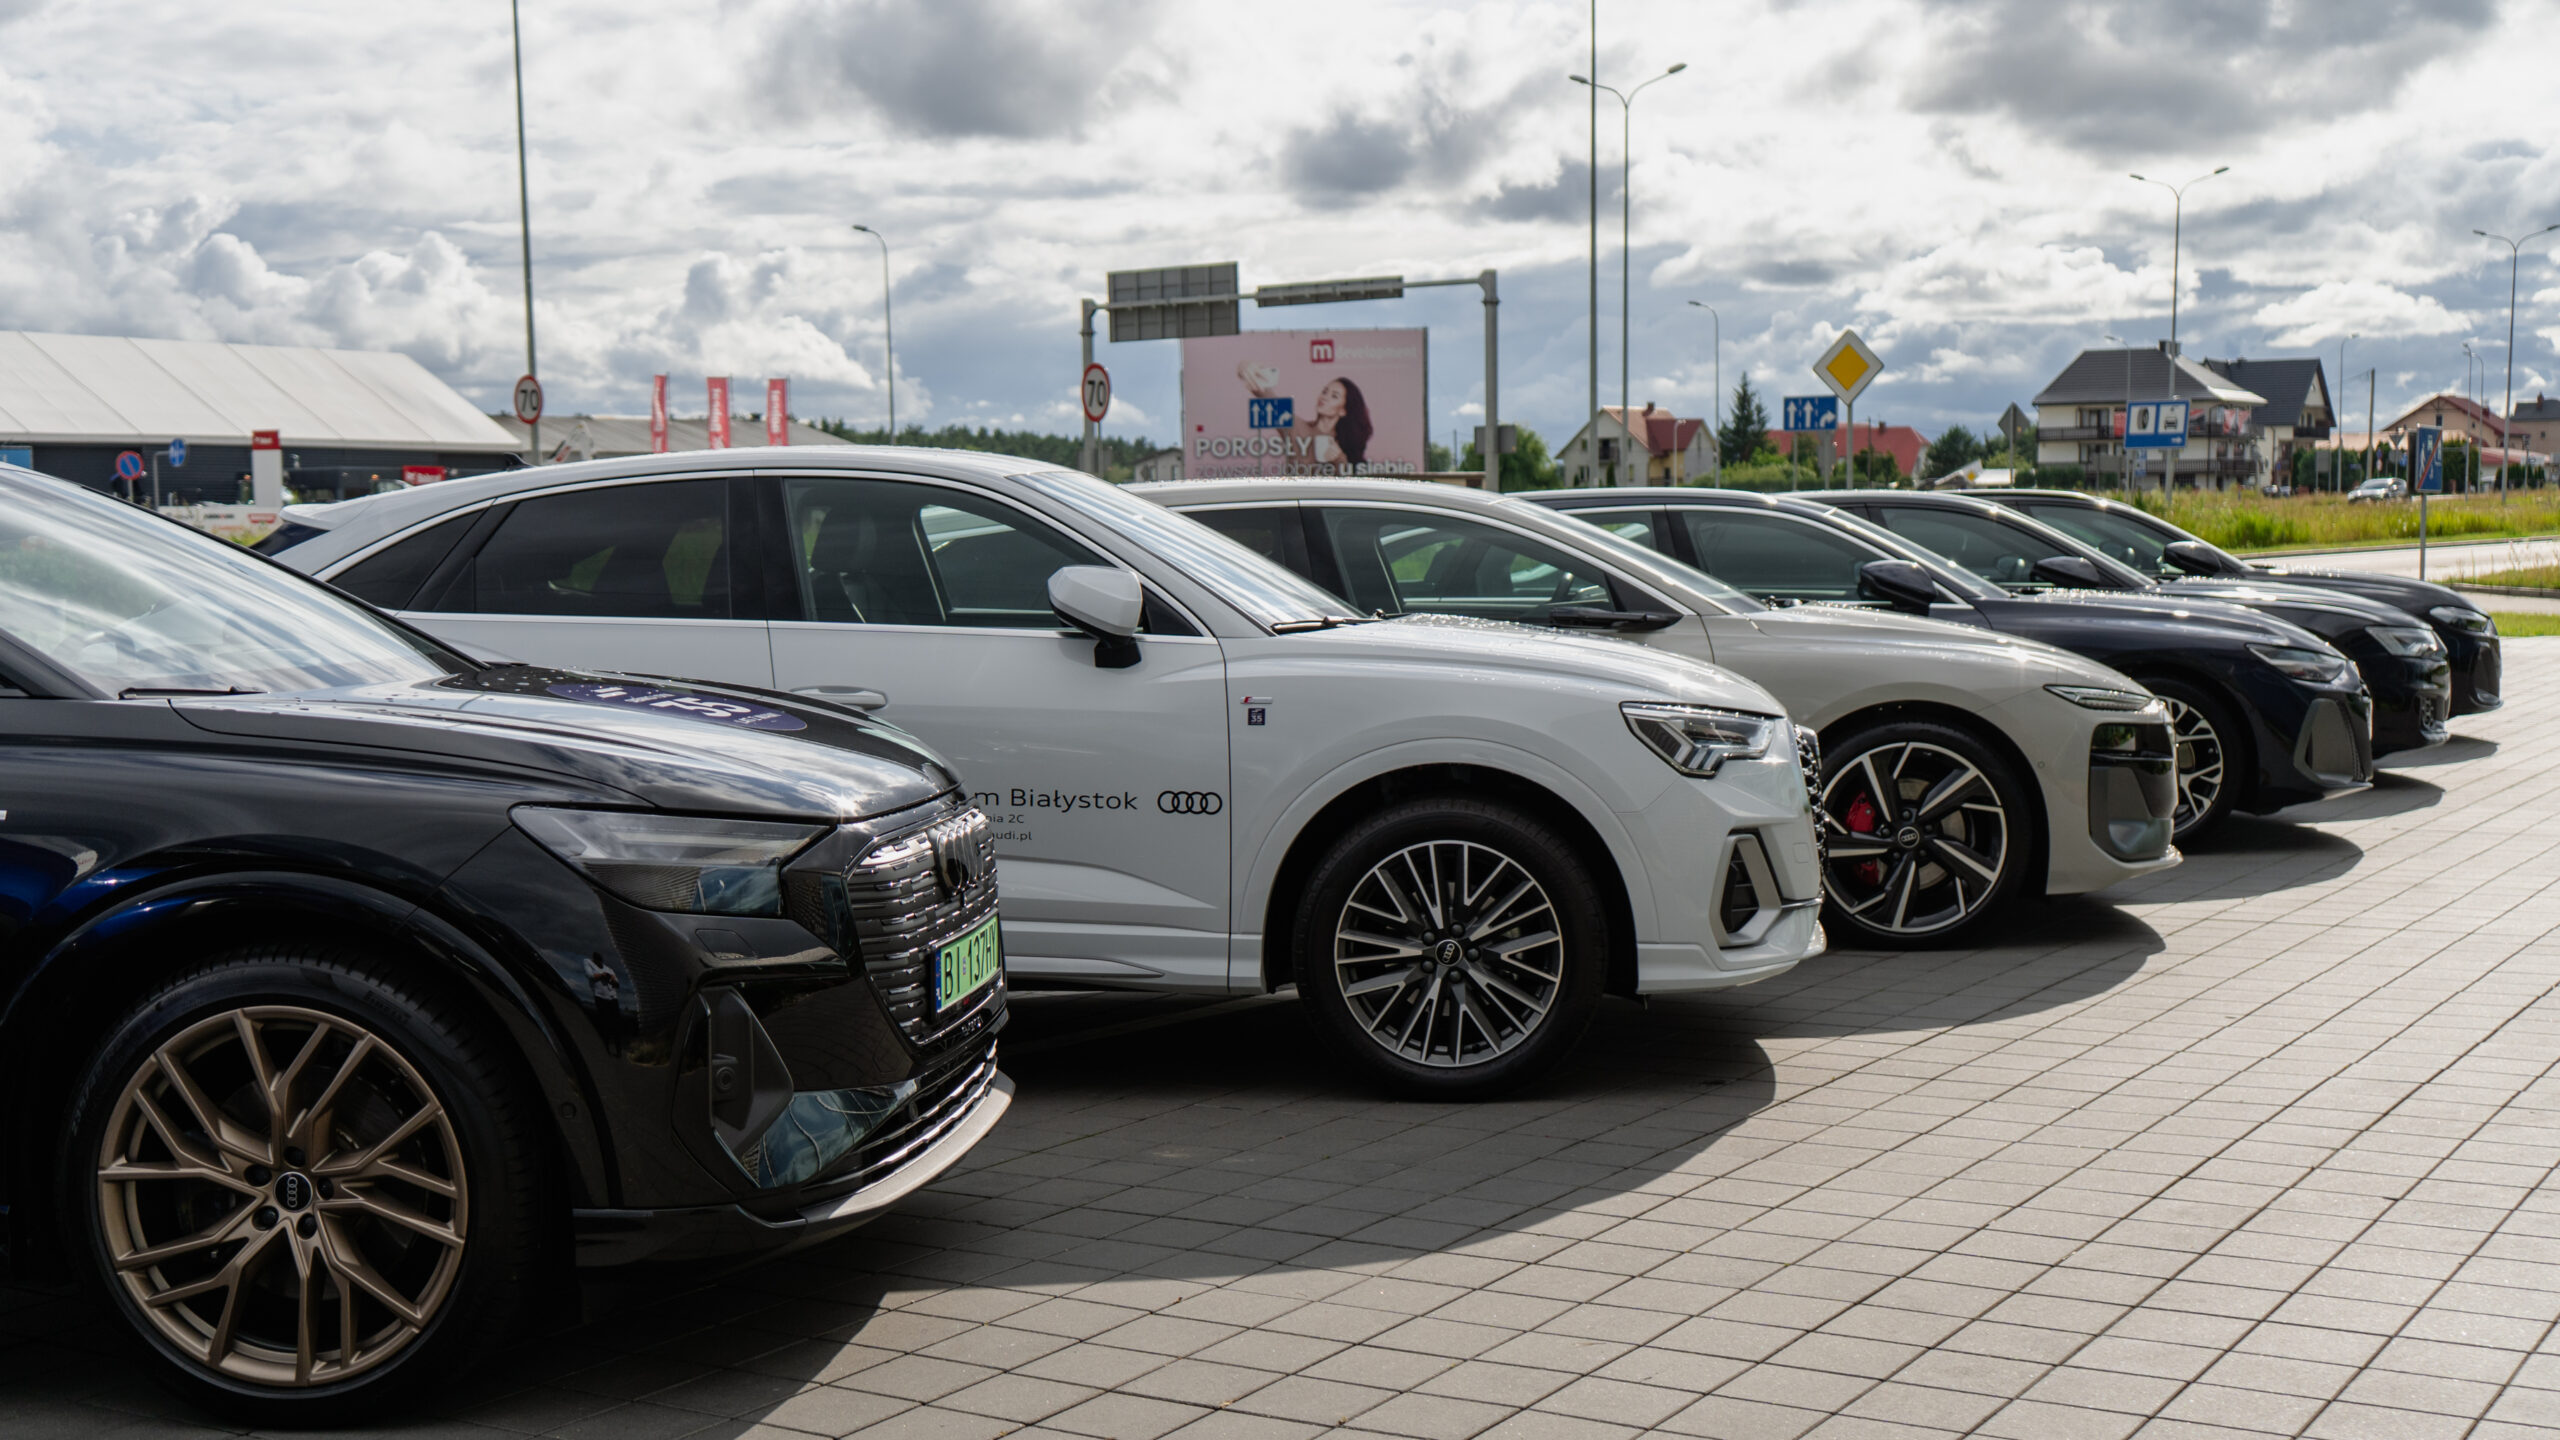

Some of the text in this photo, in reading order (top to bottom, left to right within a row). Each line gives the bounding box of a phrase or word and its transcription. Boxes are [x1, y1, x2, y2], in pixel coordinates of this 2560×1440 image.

[1312, 344, 1333, 361] m
[520, 389, 539, 412] 70
[1088, 380, 1106, 407] 70
[1195, 434, 1313, 458] POROSŁY
[1338, 463, 1354, 476] u
[1356, 457, 1416, 476] siebie
[1011, 788, 1138, 813] Białystok
[1008, 814, 1025, 824] 2C
[944, 947, 960, 1000] BI
